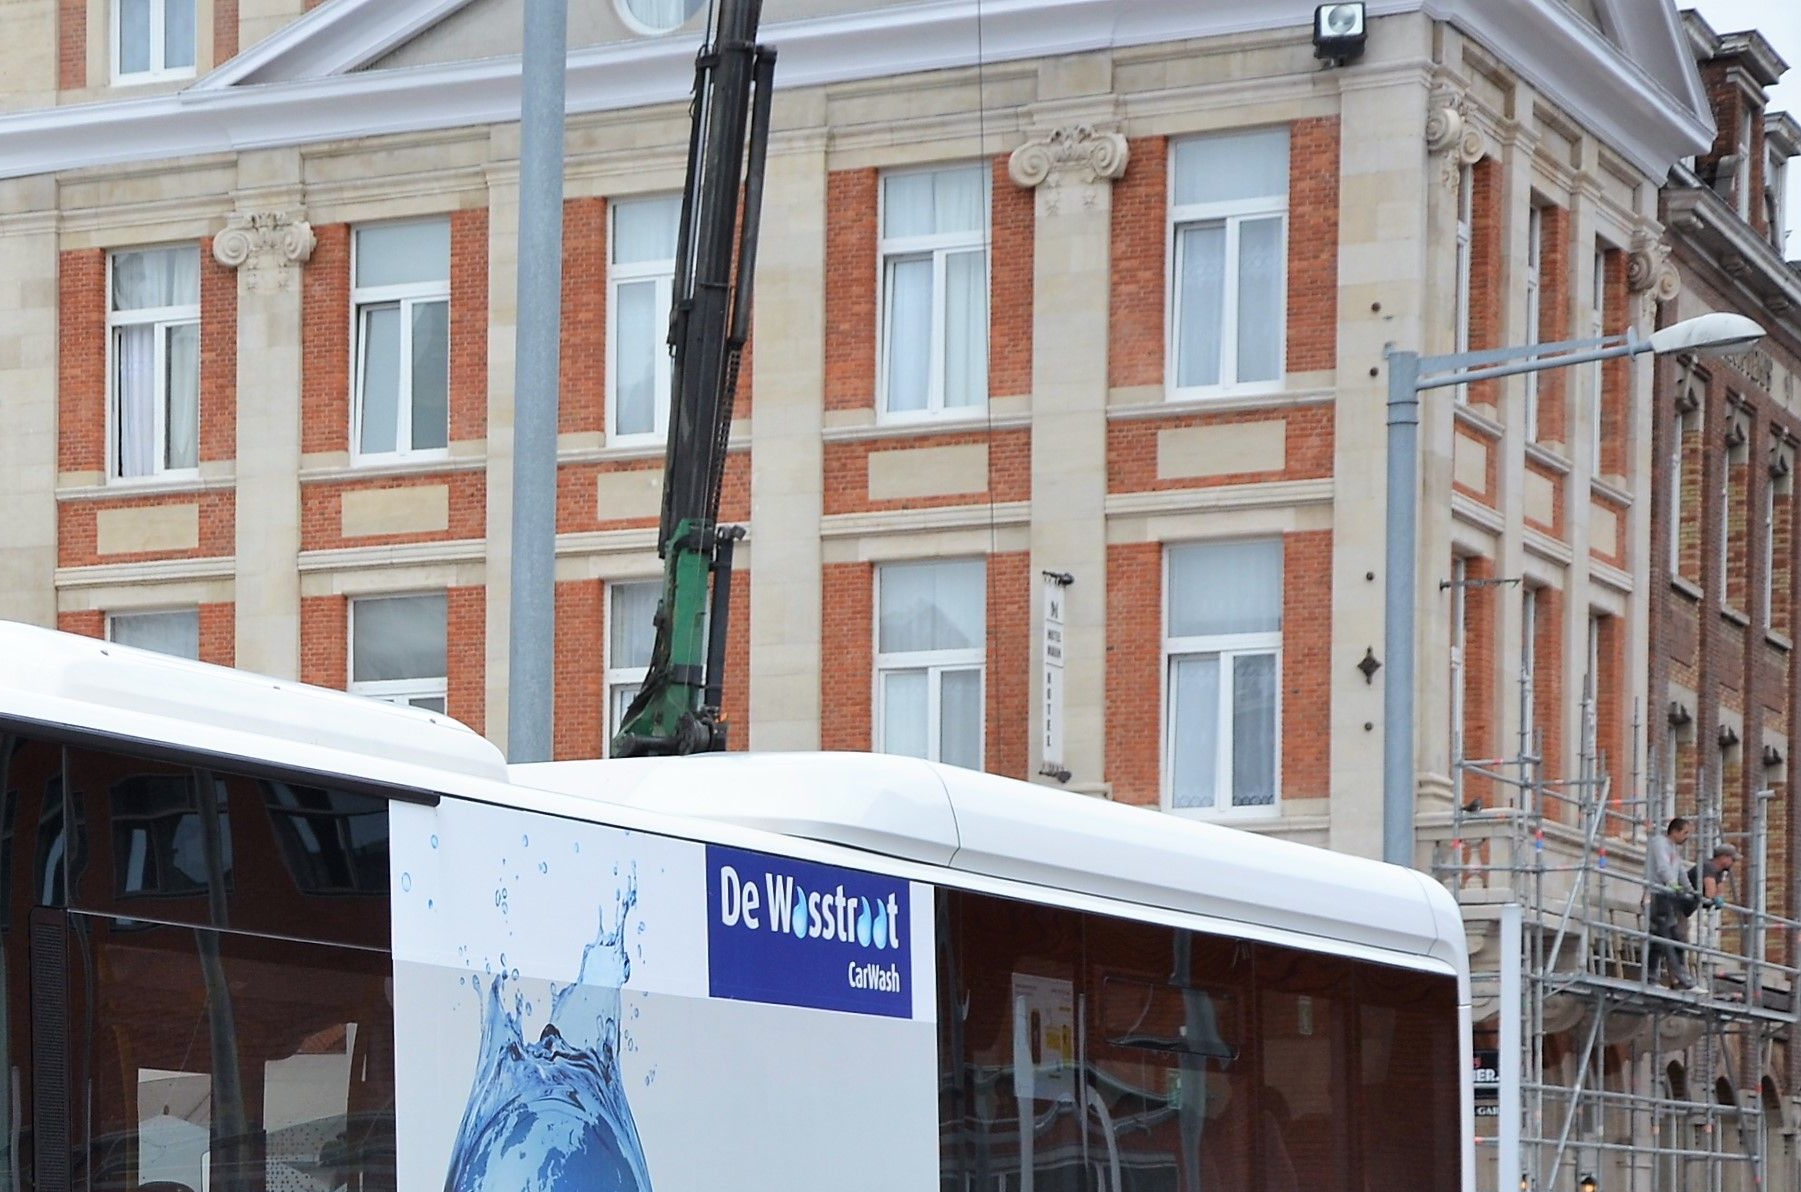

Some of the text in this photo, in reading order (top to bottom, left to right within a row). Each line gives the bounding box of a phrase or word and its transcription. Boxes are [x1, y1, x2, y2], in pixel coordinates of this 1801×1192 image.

[720, 865, 899, 950] De Wasstraat
[848, 961, 900, 993] CarWash
